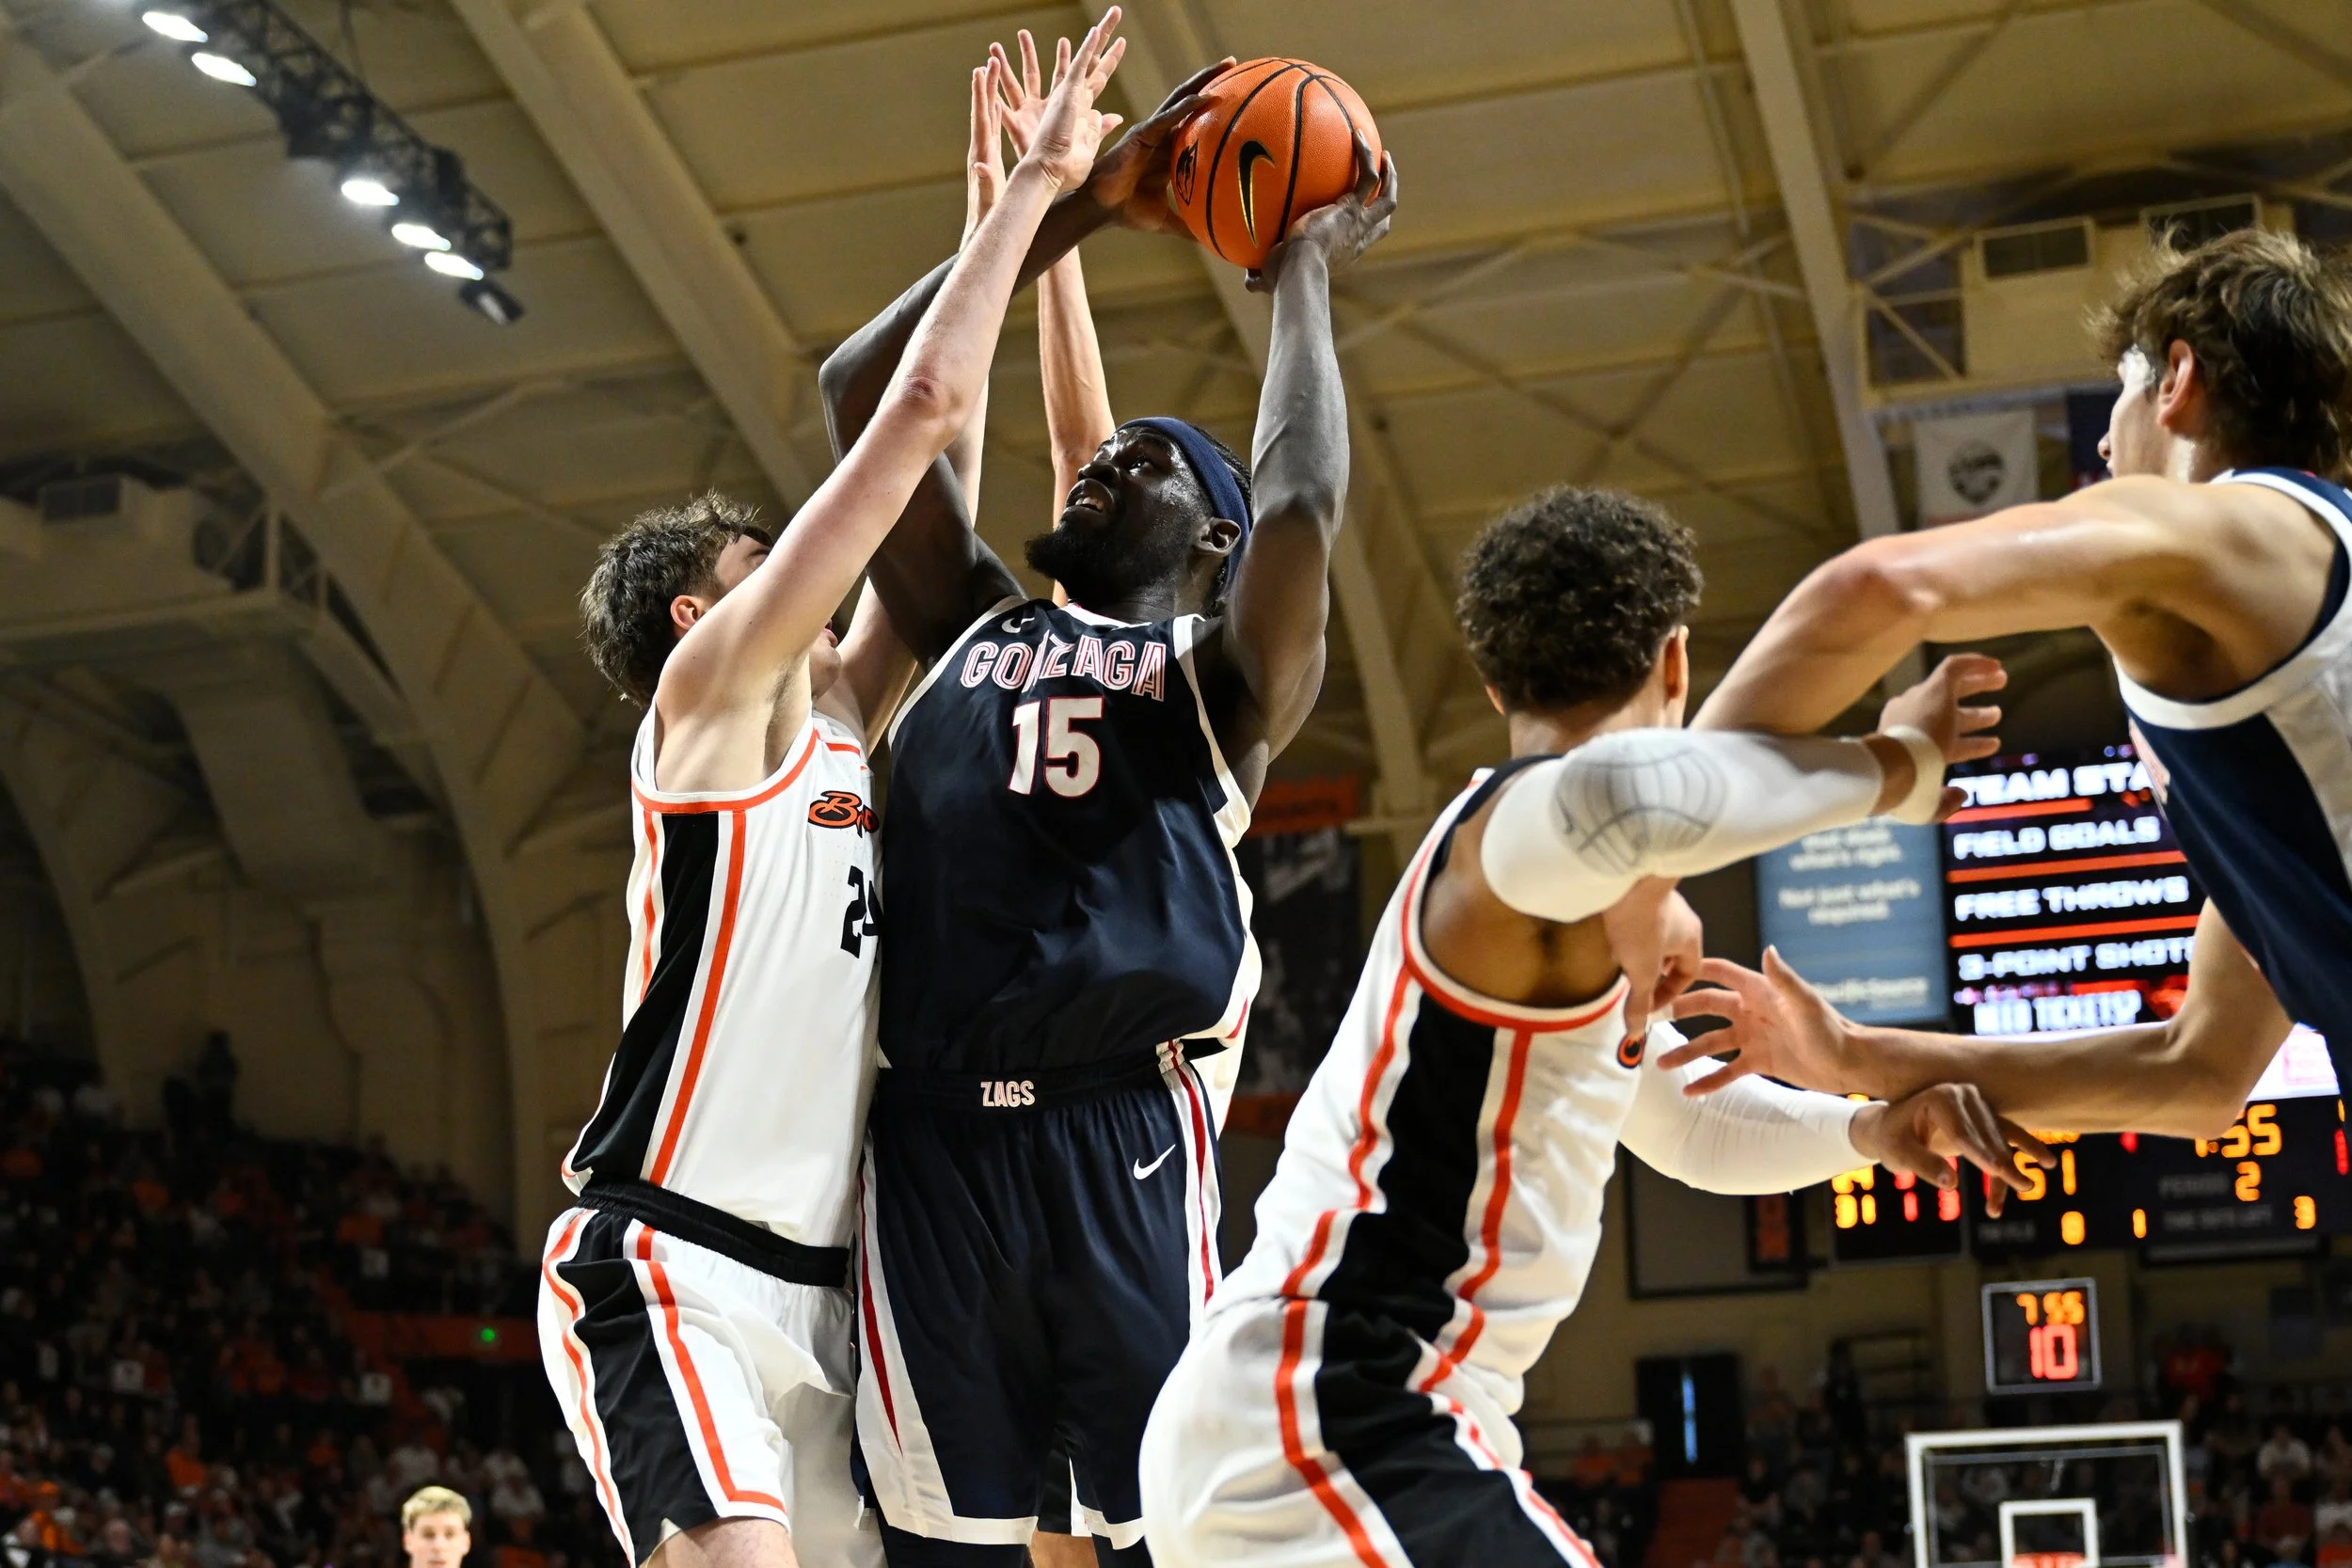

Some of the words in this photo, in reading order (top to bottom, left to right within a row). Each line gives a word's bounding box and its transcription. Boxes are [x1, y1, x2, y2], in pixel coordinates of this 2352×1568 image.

[1008, 696, 1105, 798] 15
[1947, 768, 2070, 807] TEAM
[1953, 827, 2047, 860] FIELD
[2048, 816, 2161, 851] GOALS
[1955, 889, 2042, 922] FREE
[2042, 875, 2190, 913] THROWS
[1958, 944, 2092, 982] 3-POINT
[980, 1080, 1036, 1108] ZAGS
[2234, 1161, 2262, 1202] 2
[2028, 1324, 2078, 1380] 10
